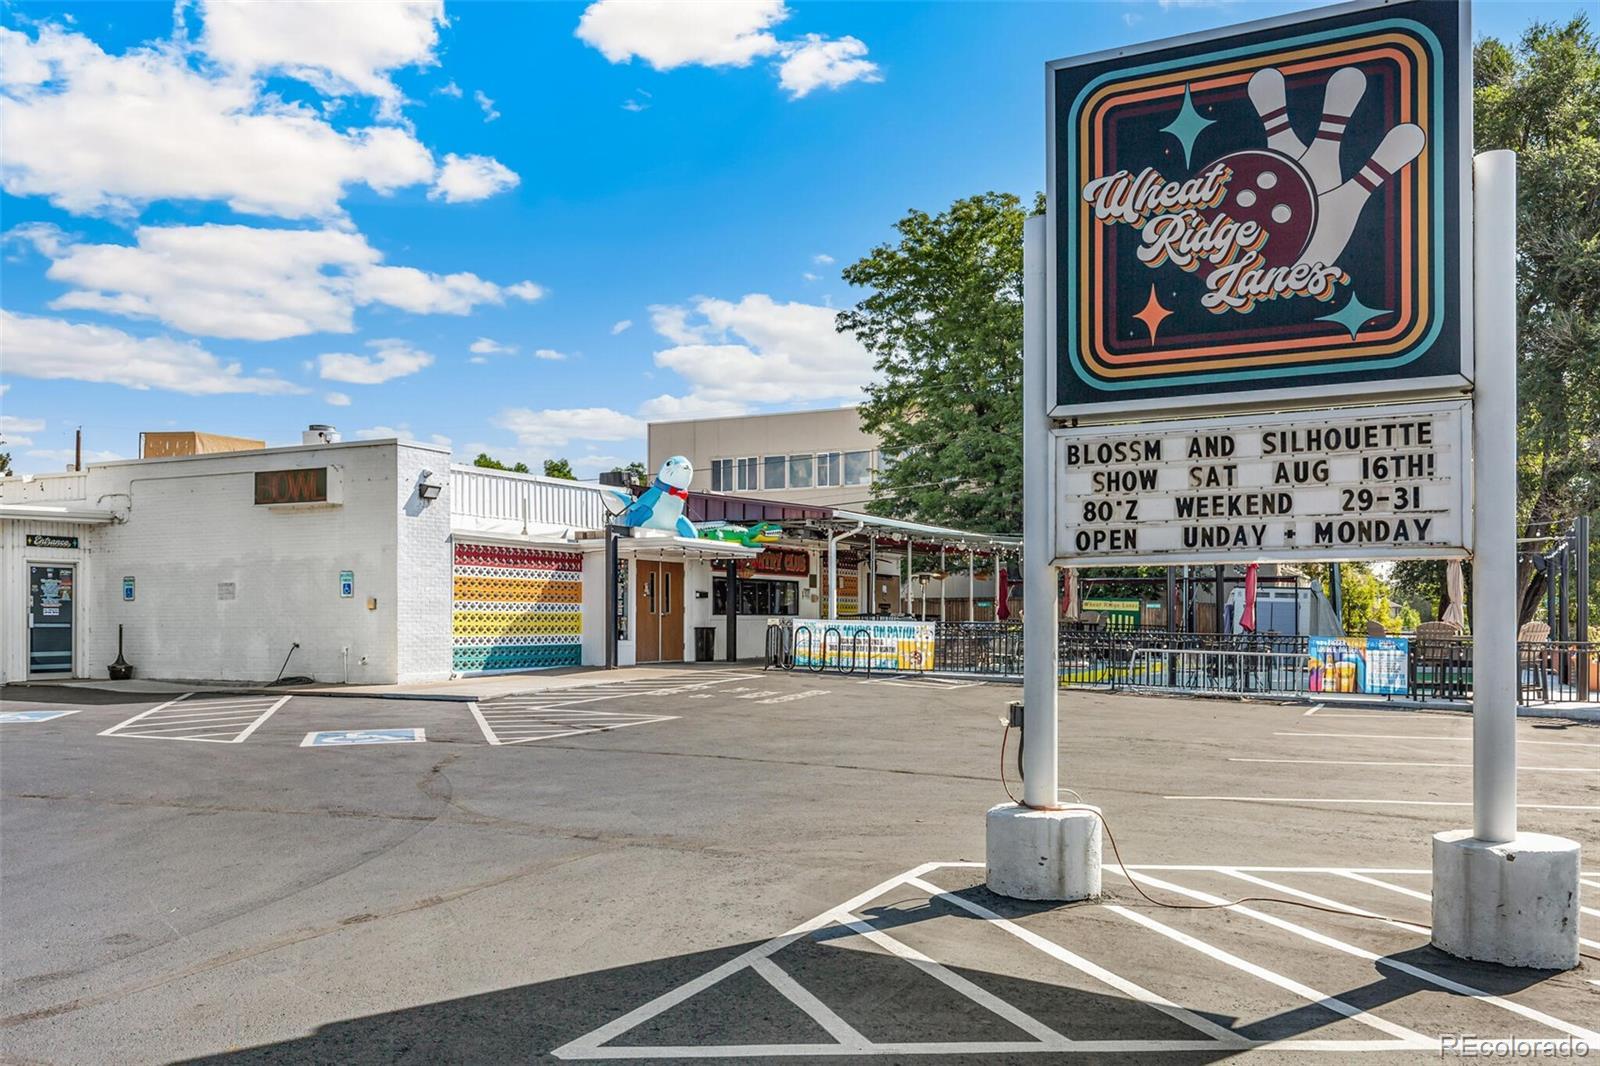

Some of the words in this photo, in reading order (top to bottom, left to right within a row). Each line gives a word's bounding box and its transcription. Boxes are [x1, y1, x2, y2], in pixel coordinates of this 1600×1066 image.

[1082, 163, 1229, 226] Wheat
[1137, 209, 1265, 270] Ridge
[1201, 251, 1347, 312] Lanes
[1066, 439, 1162, 466] BLOSSM
[1187, 435, 1236, 458] AND
[1262, 421, 1433, 454] SILHOUETTE
[1092, 469, 1158, 493] SHOW
[1190, 465, 1238, 488] SAT
[1274, 460, 1330, 485] AUG
[1361, 453, 1435, 480] 16TH!
[1175, 492, 1293, 519] WEEKEND
[1342, 486, 1421, 511] 29-31
[33, 535, 71, 547] Entrance
[1075, 528, 1138, 552] OPEN
[1183, 524, 1267, 549] UNDAY
[1314, 518, 1432, 544] MONDAY
